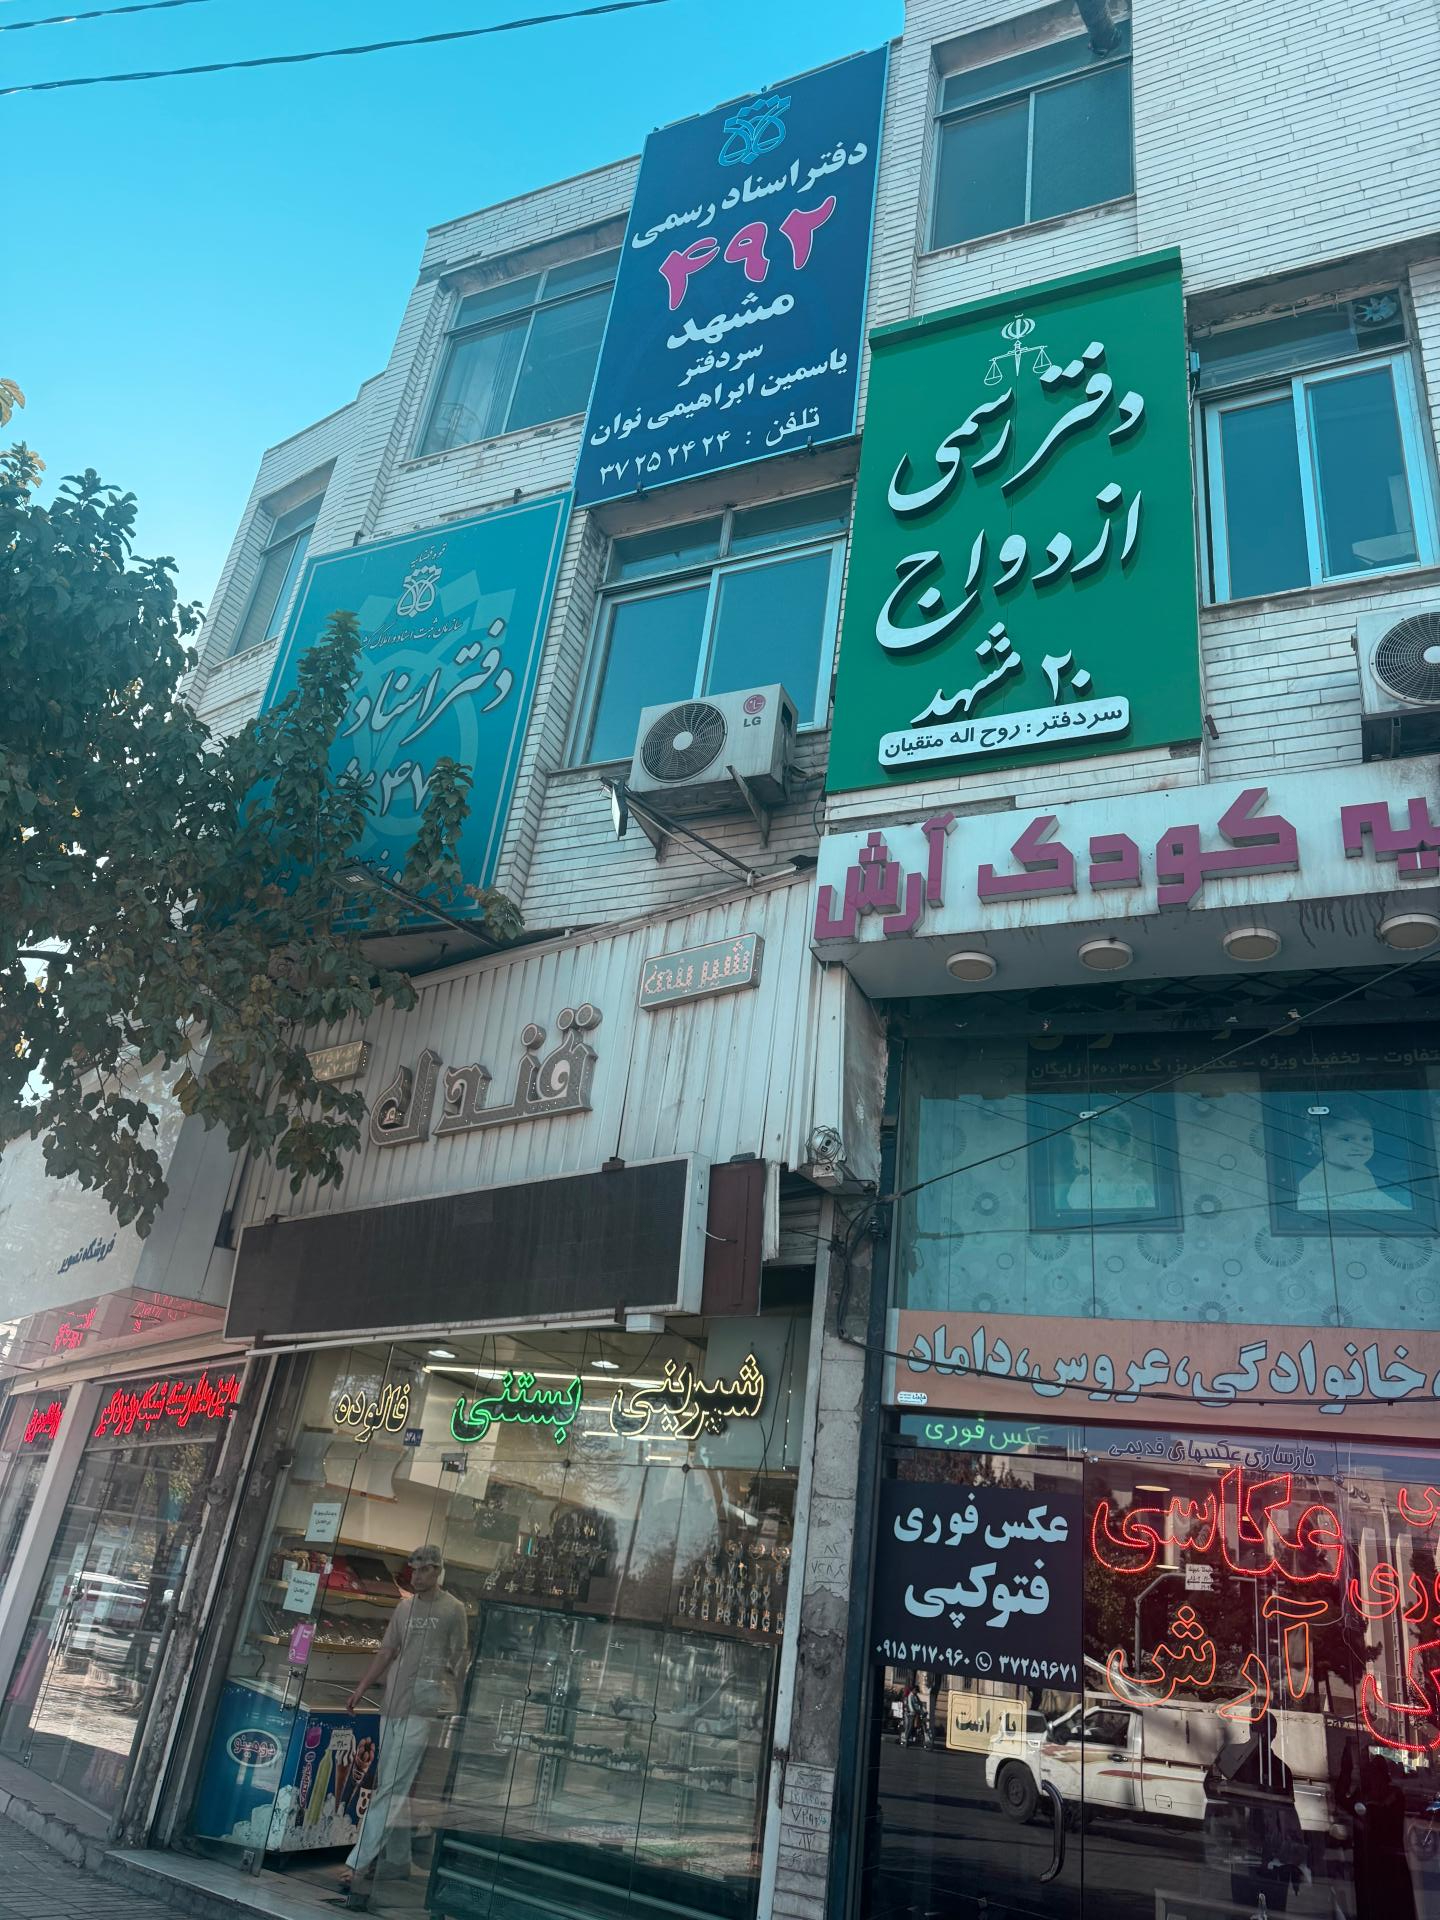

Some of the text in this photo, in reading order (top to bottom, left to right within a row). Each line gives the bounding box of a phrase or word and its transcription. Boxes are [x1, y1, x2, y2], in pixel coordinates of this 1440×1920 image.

[631, 141, 868, 249] دفتر اسناد رسمی
[658, 195, 836, 311] ۴۹۲
[666, 292, 795, 350] مشهد
[590, 348, 848, 447] یاسمین ابراهیمی نوان
[765, 405, 820, 447] تلفن
[888, 341, 1145, 513] دفتر رسمی
[876, 483, 1142, 650] ازدواج
[341, 667, 442, 738] اسناد
[400, 618, 514, 747] دفتر
[910, 621, 1022, 728] مشهد
[743, 716, 761, 728] LG
[884, 735, 944, 760] متقیان
[950, 727, 975, 745] اله
[980, 721, 1021, 748] روح
[814, 811, 958, 943] آرش
[978, 787, 1299, 913] کودک
[1260, 1056, 1297, 1071] ویژه
[1303, 1051, 1361, 1067] تخفیف
[907, 1324, 1012, 1376] داماد
[333, 1383, 410, 1443] فالوده
[450, 1370, 583, 1445] بستنی
[609, 1352, 766, 1441] شیرینی
[925, 1418, 1049, 1450] عکس فوری
[1108, 1437, 1316, 1472] بازسازی عکسهای قدیمی
[893, 1492, 1069, 1549] عکس فوری
[1091, 1467, 1345, 1581] عکاسی
[904, 1558, 1050, 1629] فتوکپی
[999, 1654, 1078, 1683] ۳۷۲۵۹۶۷۱
[1106, 1595, 1329, 1723] آرش
[233, 1734, 276, 1757] دومینو
